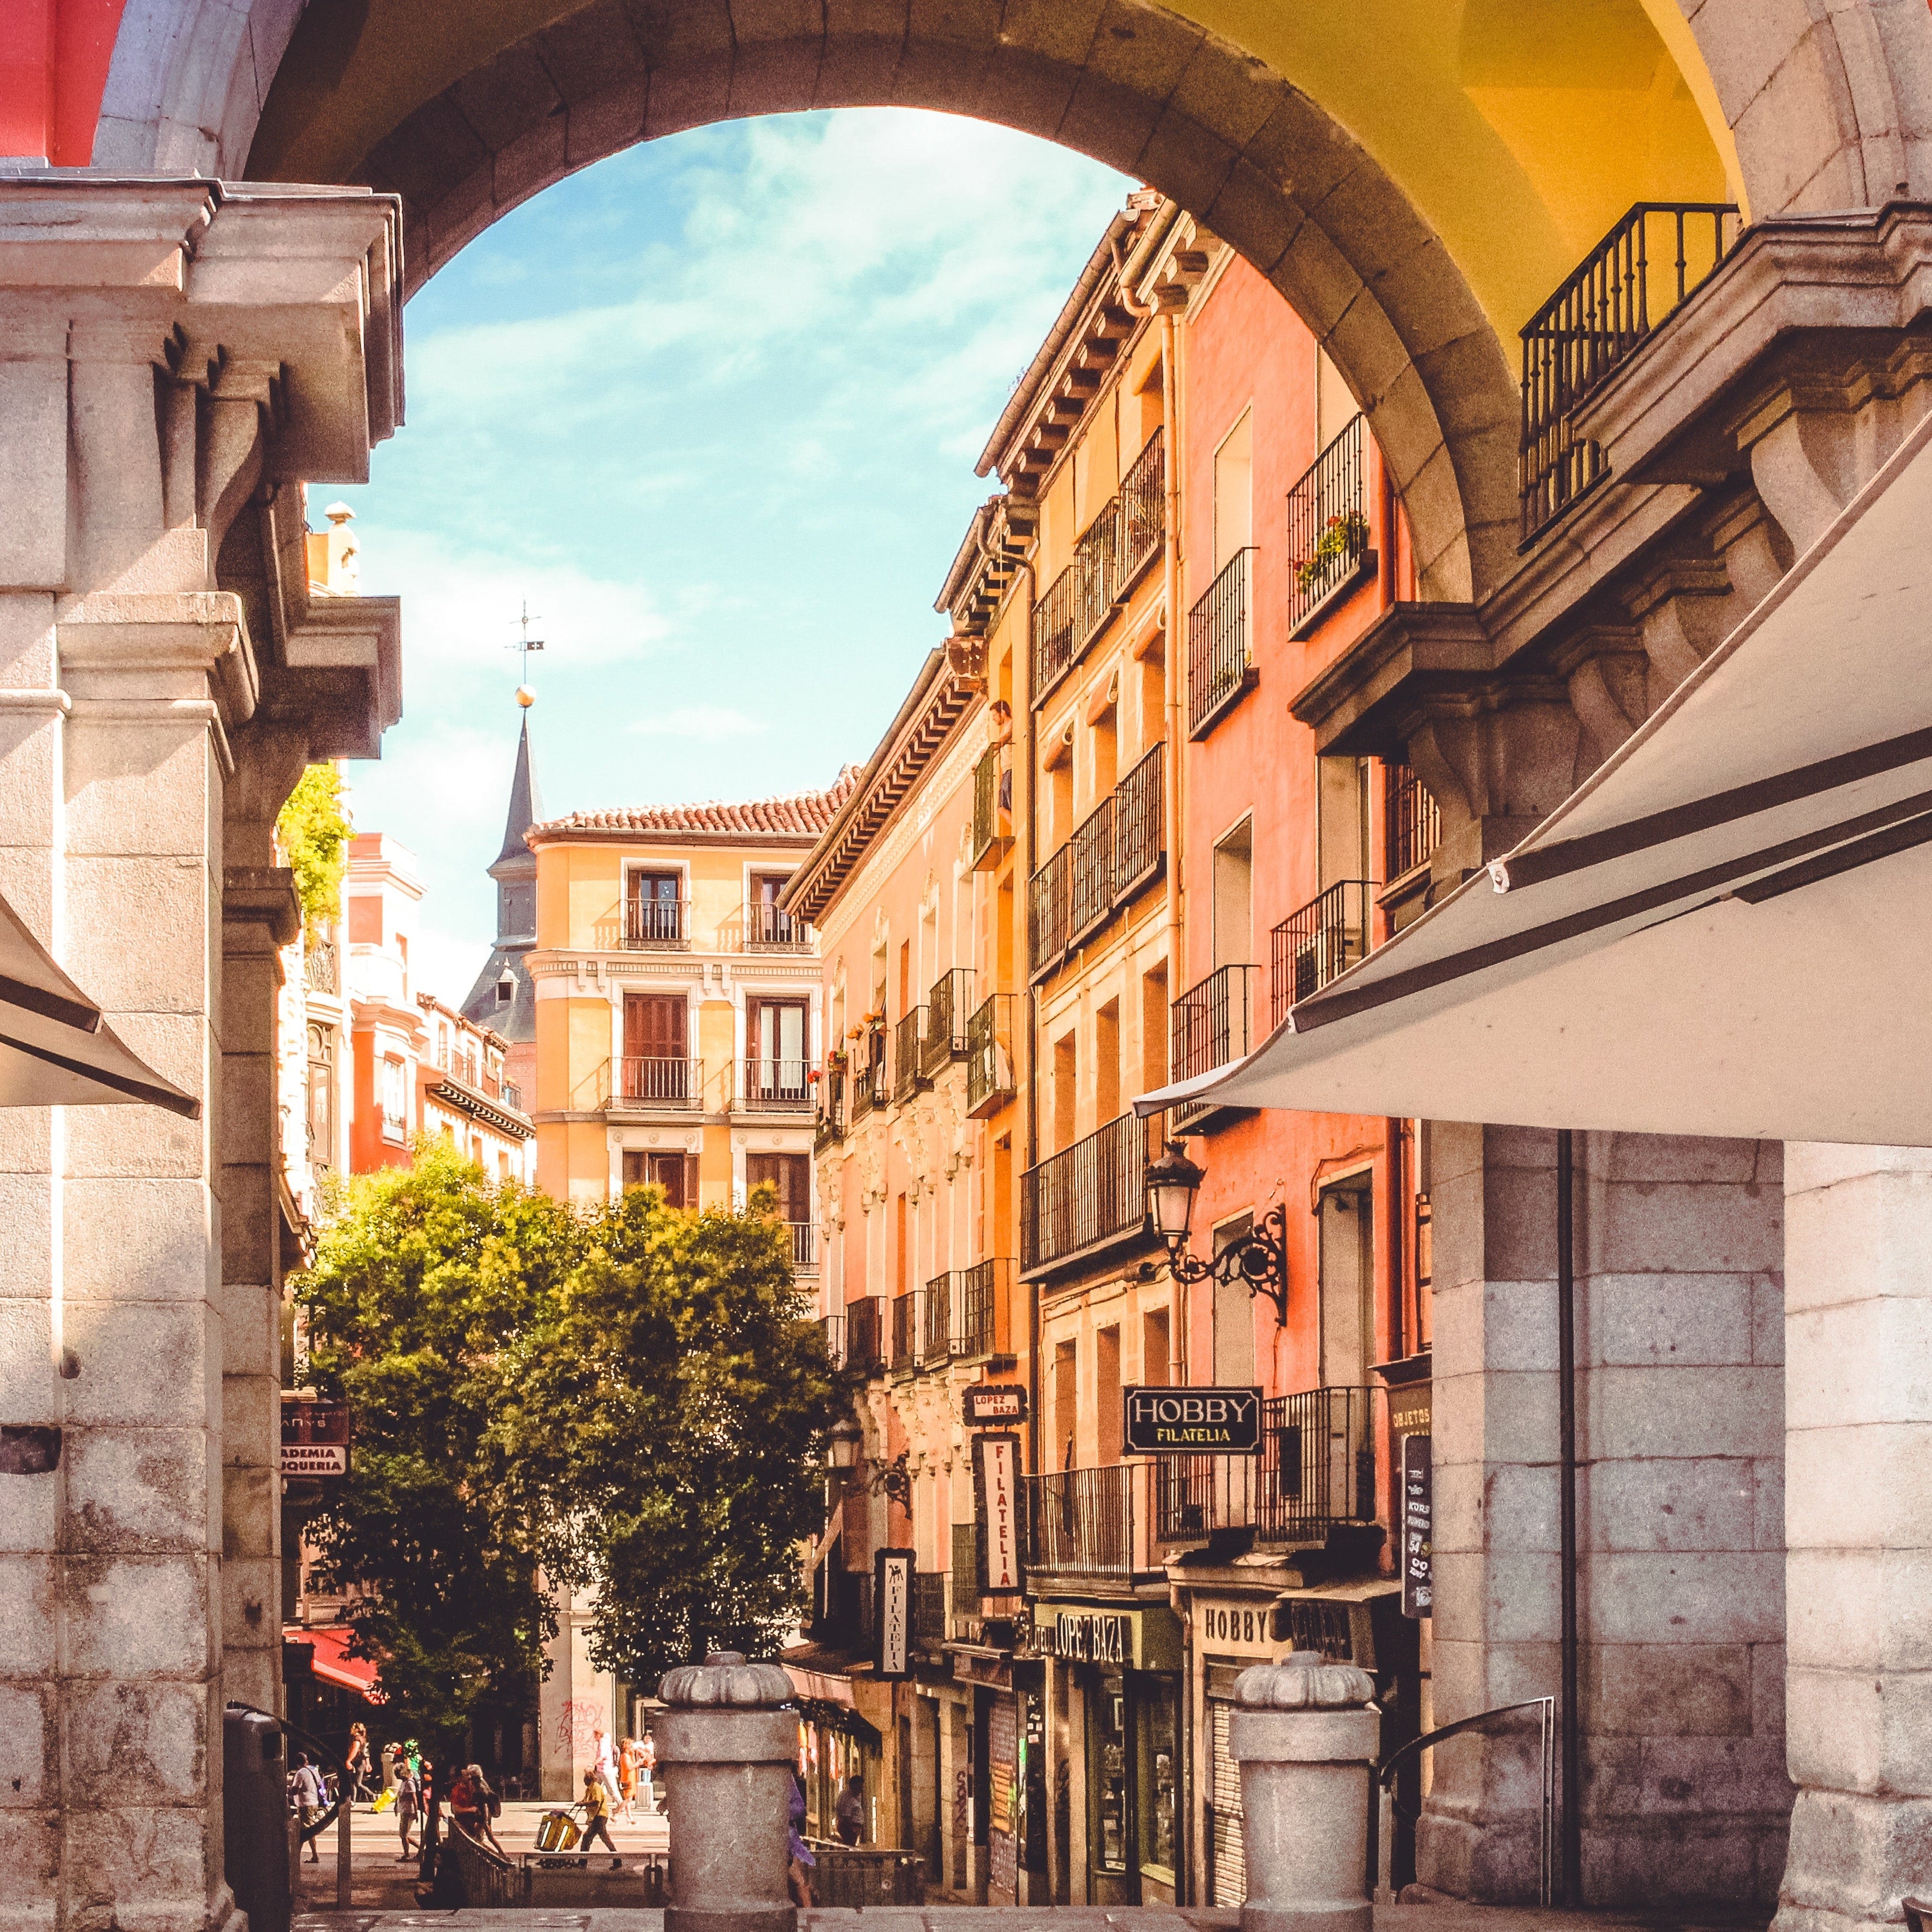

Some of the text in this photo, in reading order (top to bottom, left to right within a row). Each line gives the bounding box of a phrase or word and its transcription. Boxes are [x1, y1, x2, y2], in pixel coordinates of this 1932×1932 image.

[976, 1395, 1005, 1405] LOPEZ
[993, 1406, 1018, 1415] BAZA
[1135, 1399, 1252, 1422] HOBBY
[1157, 1428, 1231, 1442] FILATELIA
[281, 1449, 336, 1458] ADEMIA
[996, 1446, 1010, 1586] FILATELIA
[889, 1586, 902, 1670] FILATELIA
[1205, 1609, 1267, 1643] HOBBY
[1055, 1613, 1091, 1661] LOPEZ
[1092, 1615, 1123, 1663] BAZA
